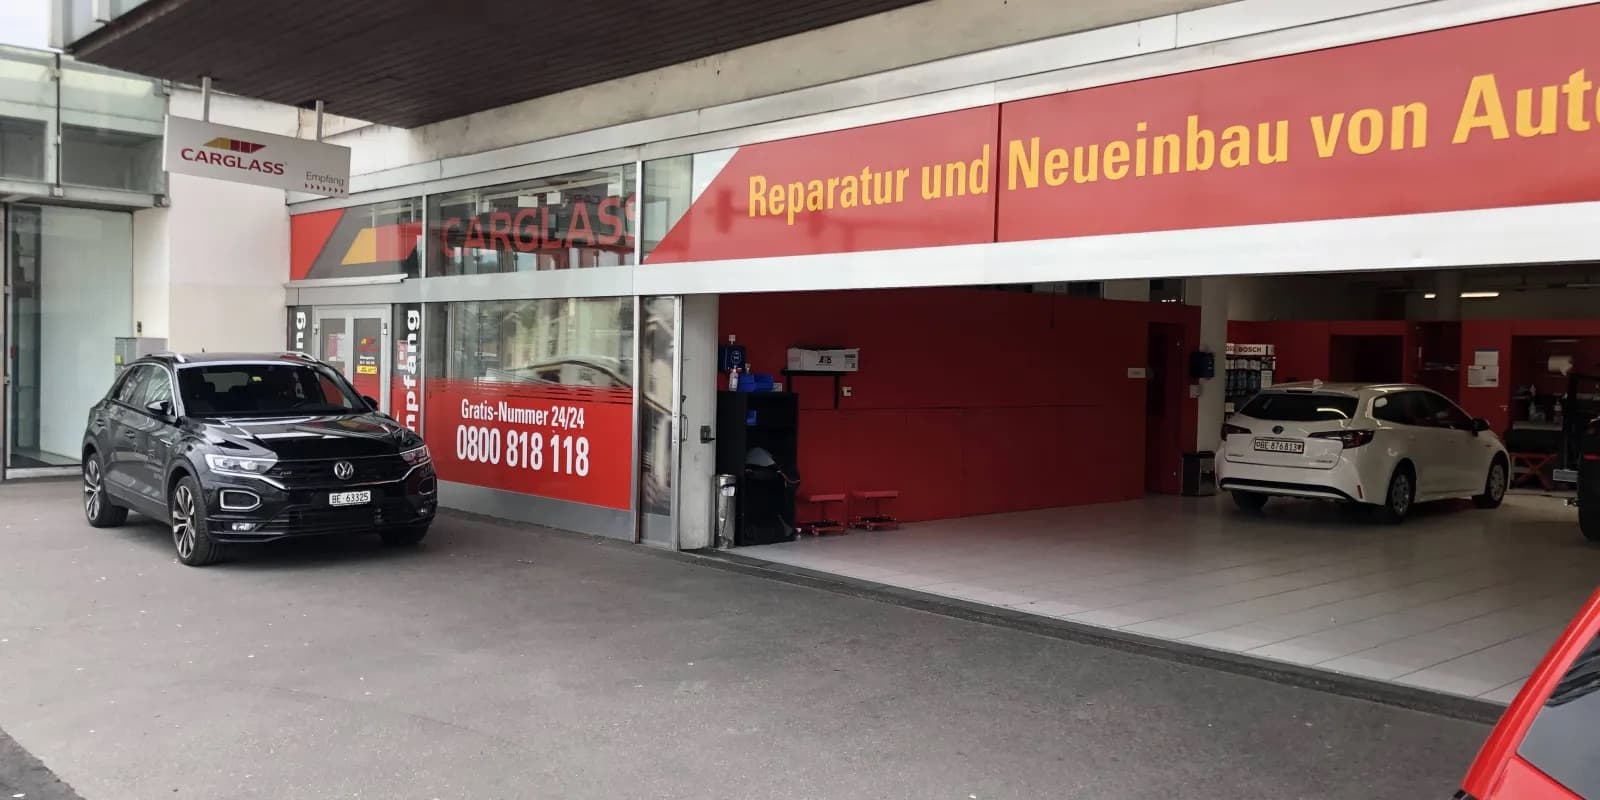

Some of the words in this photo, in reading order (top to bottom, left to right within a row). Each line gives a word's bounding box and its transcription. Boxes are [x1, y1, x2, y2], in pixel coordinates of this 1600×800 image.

[181, 148, 284, 175] CARGLASS
[749, 165, 909, 225] Reparatur
[921, 144, 990, 200] und
[1007, 114, 1289, 191] Neueinbau
[1310, 101, 1427, 158] von
[1452, 68, 1600, 144] Aut
[306, 171, 344, 186] Empfang
[403, 310, 420, 433] mpfang
[461, 398, 549, 426] Gratis-Nummer
[551, 405, 585, 430] 24/24
[456, 424, 501, 465] 0800
[506, 429, 543, 471] 818
[550, 433, 589, 477] 118
